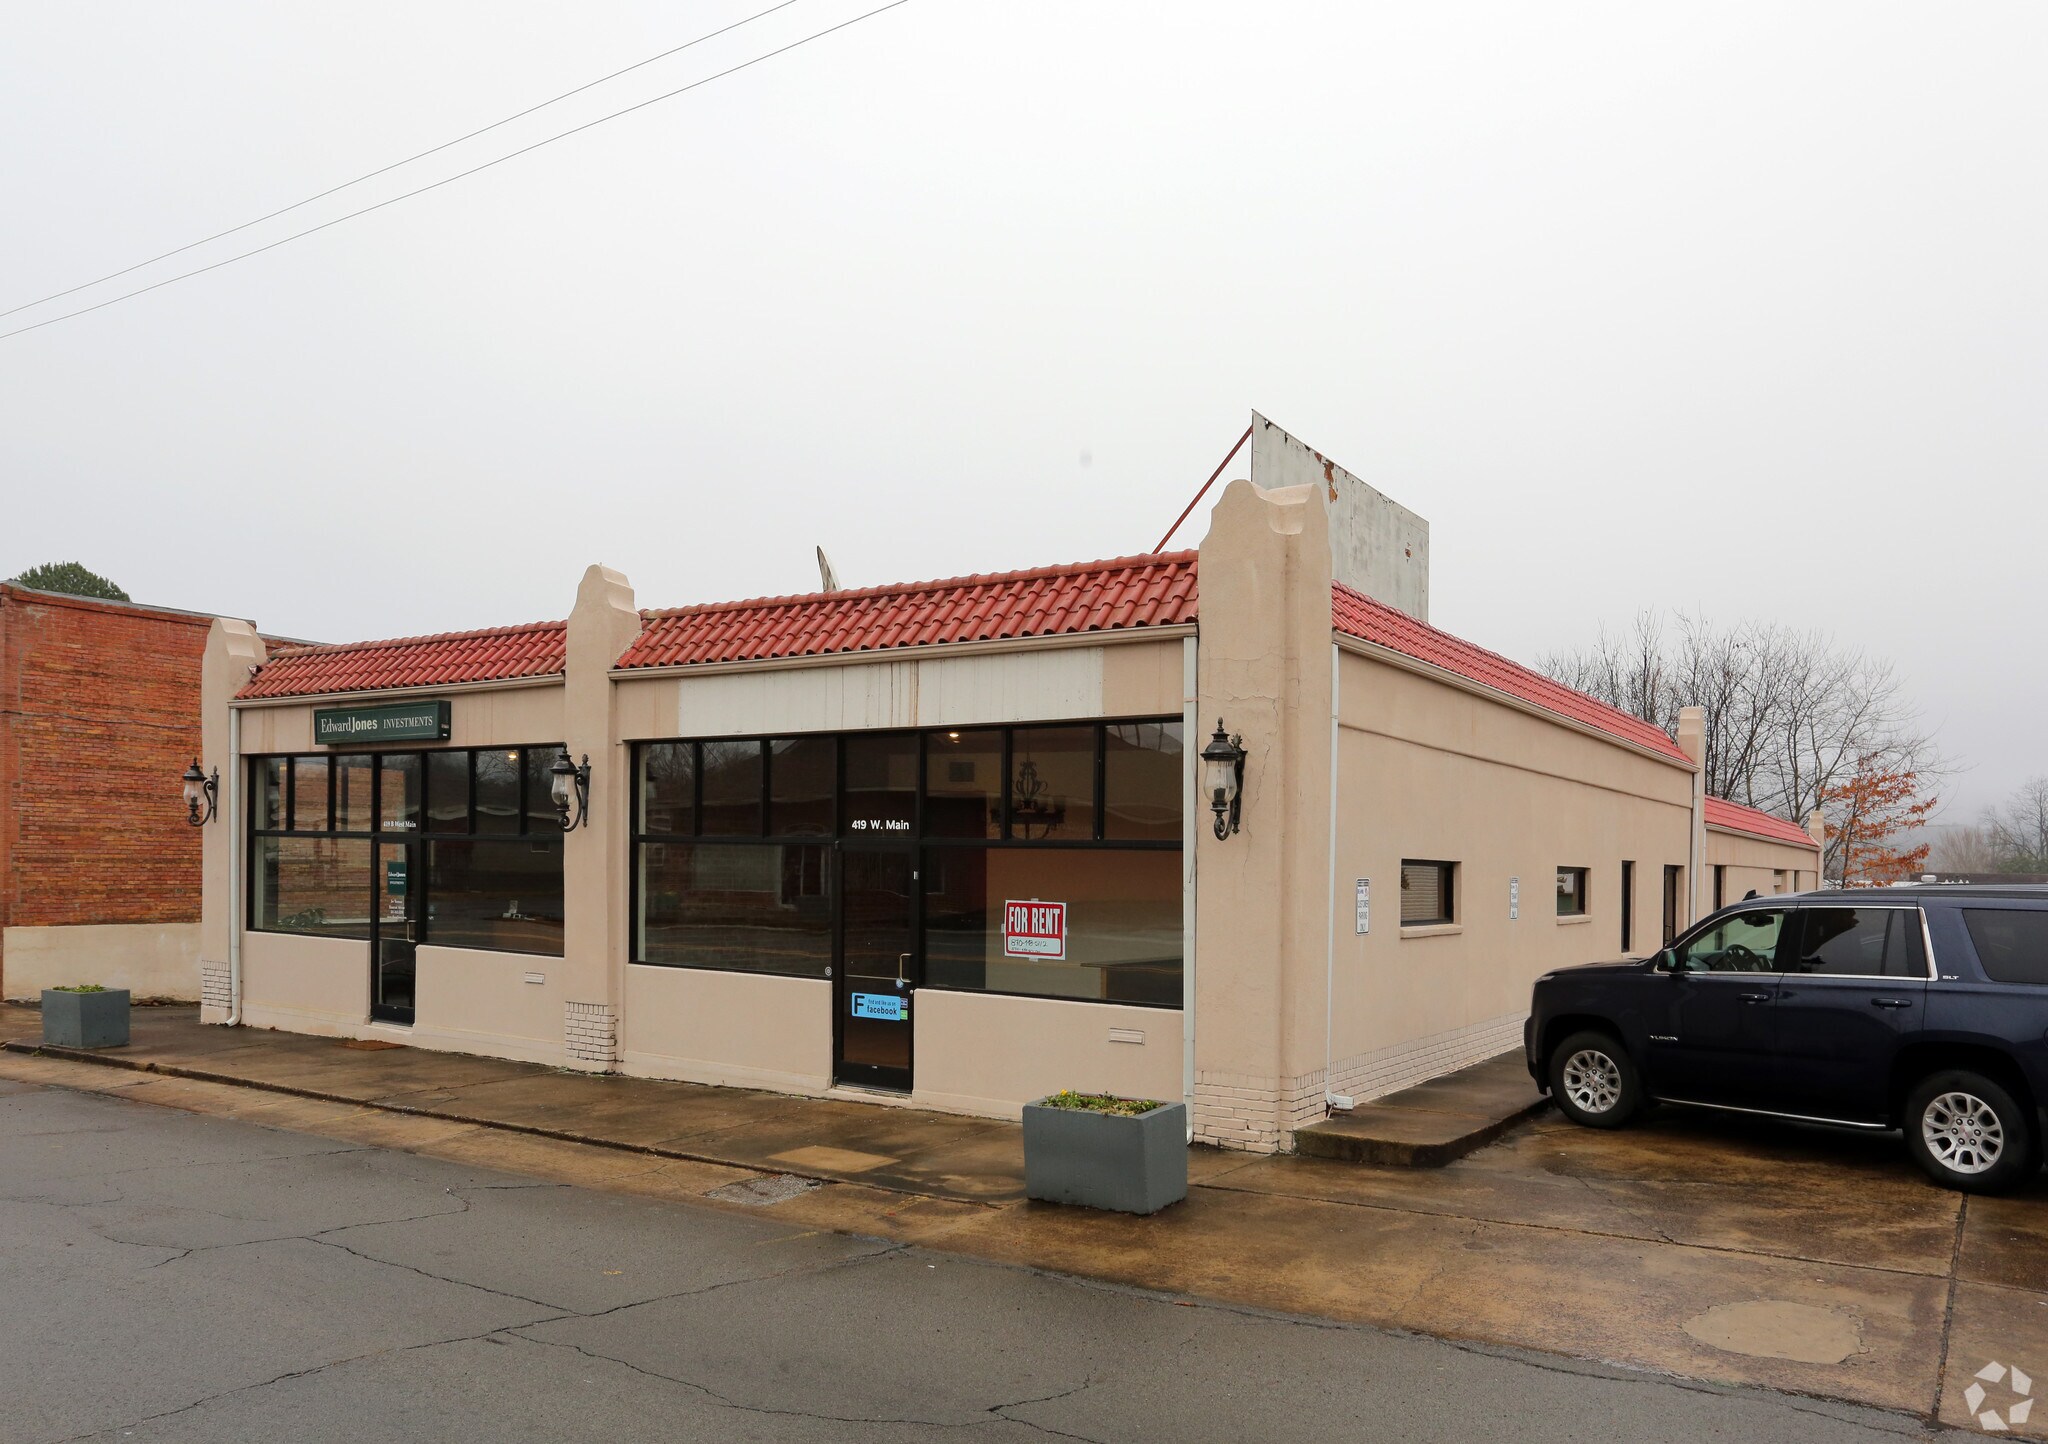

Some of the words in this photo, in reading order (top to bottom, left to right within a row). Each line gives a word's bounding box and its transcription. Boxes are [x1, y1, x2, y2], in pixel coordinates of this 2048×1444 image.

[383, 716, 433, 729] INVESTMENTS
[852, 820, 867, 830] 419
[870, 820, 883, 830] W.
[885, 820, 910, 830] Main
[1008, 906, 1028, 933] FOR
[1032, 907, 1060, 935] RENT
[854, 995, 865, 1014] F
[867, 1005, 898, 1015] facebook
